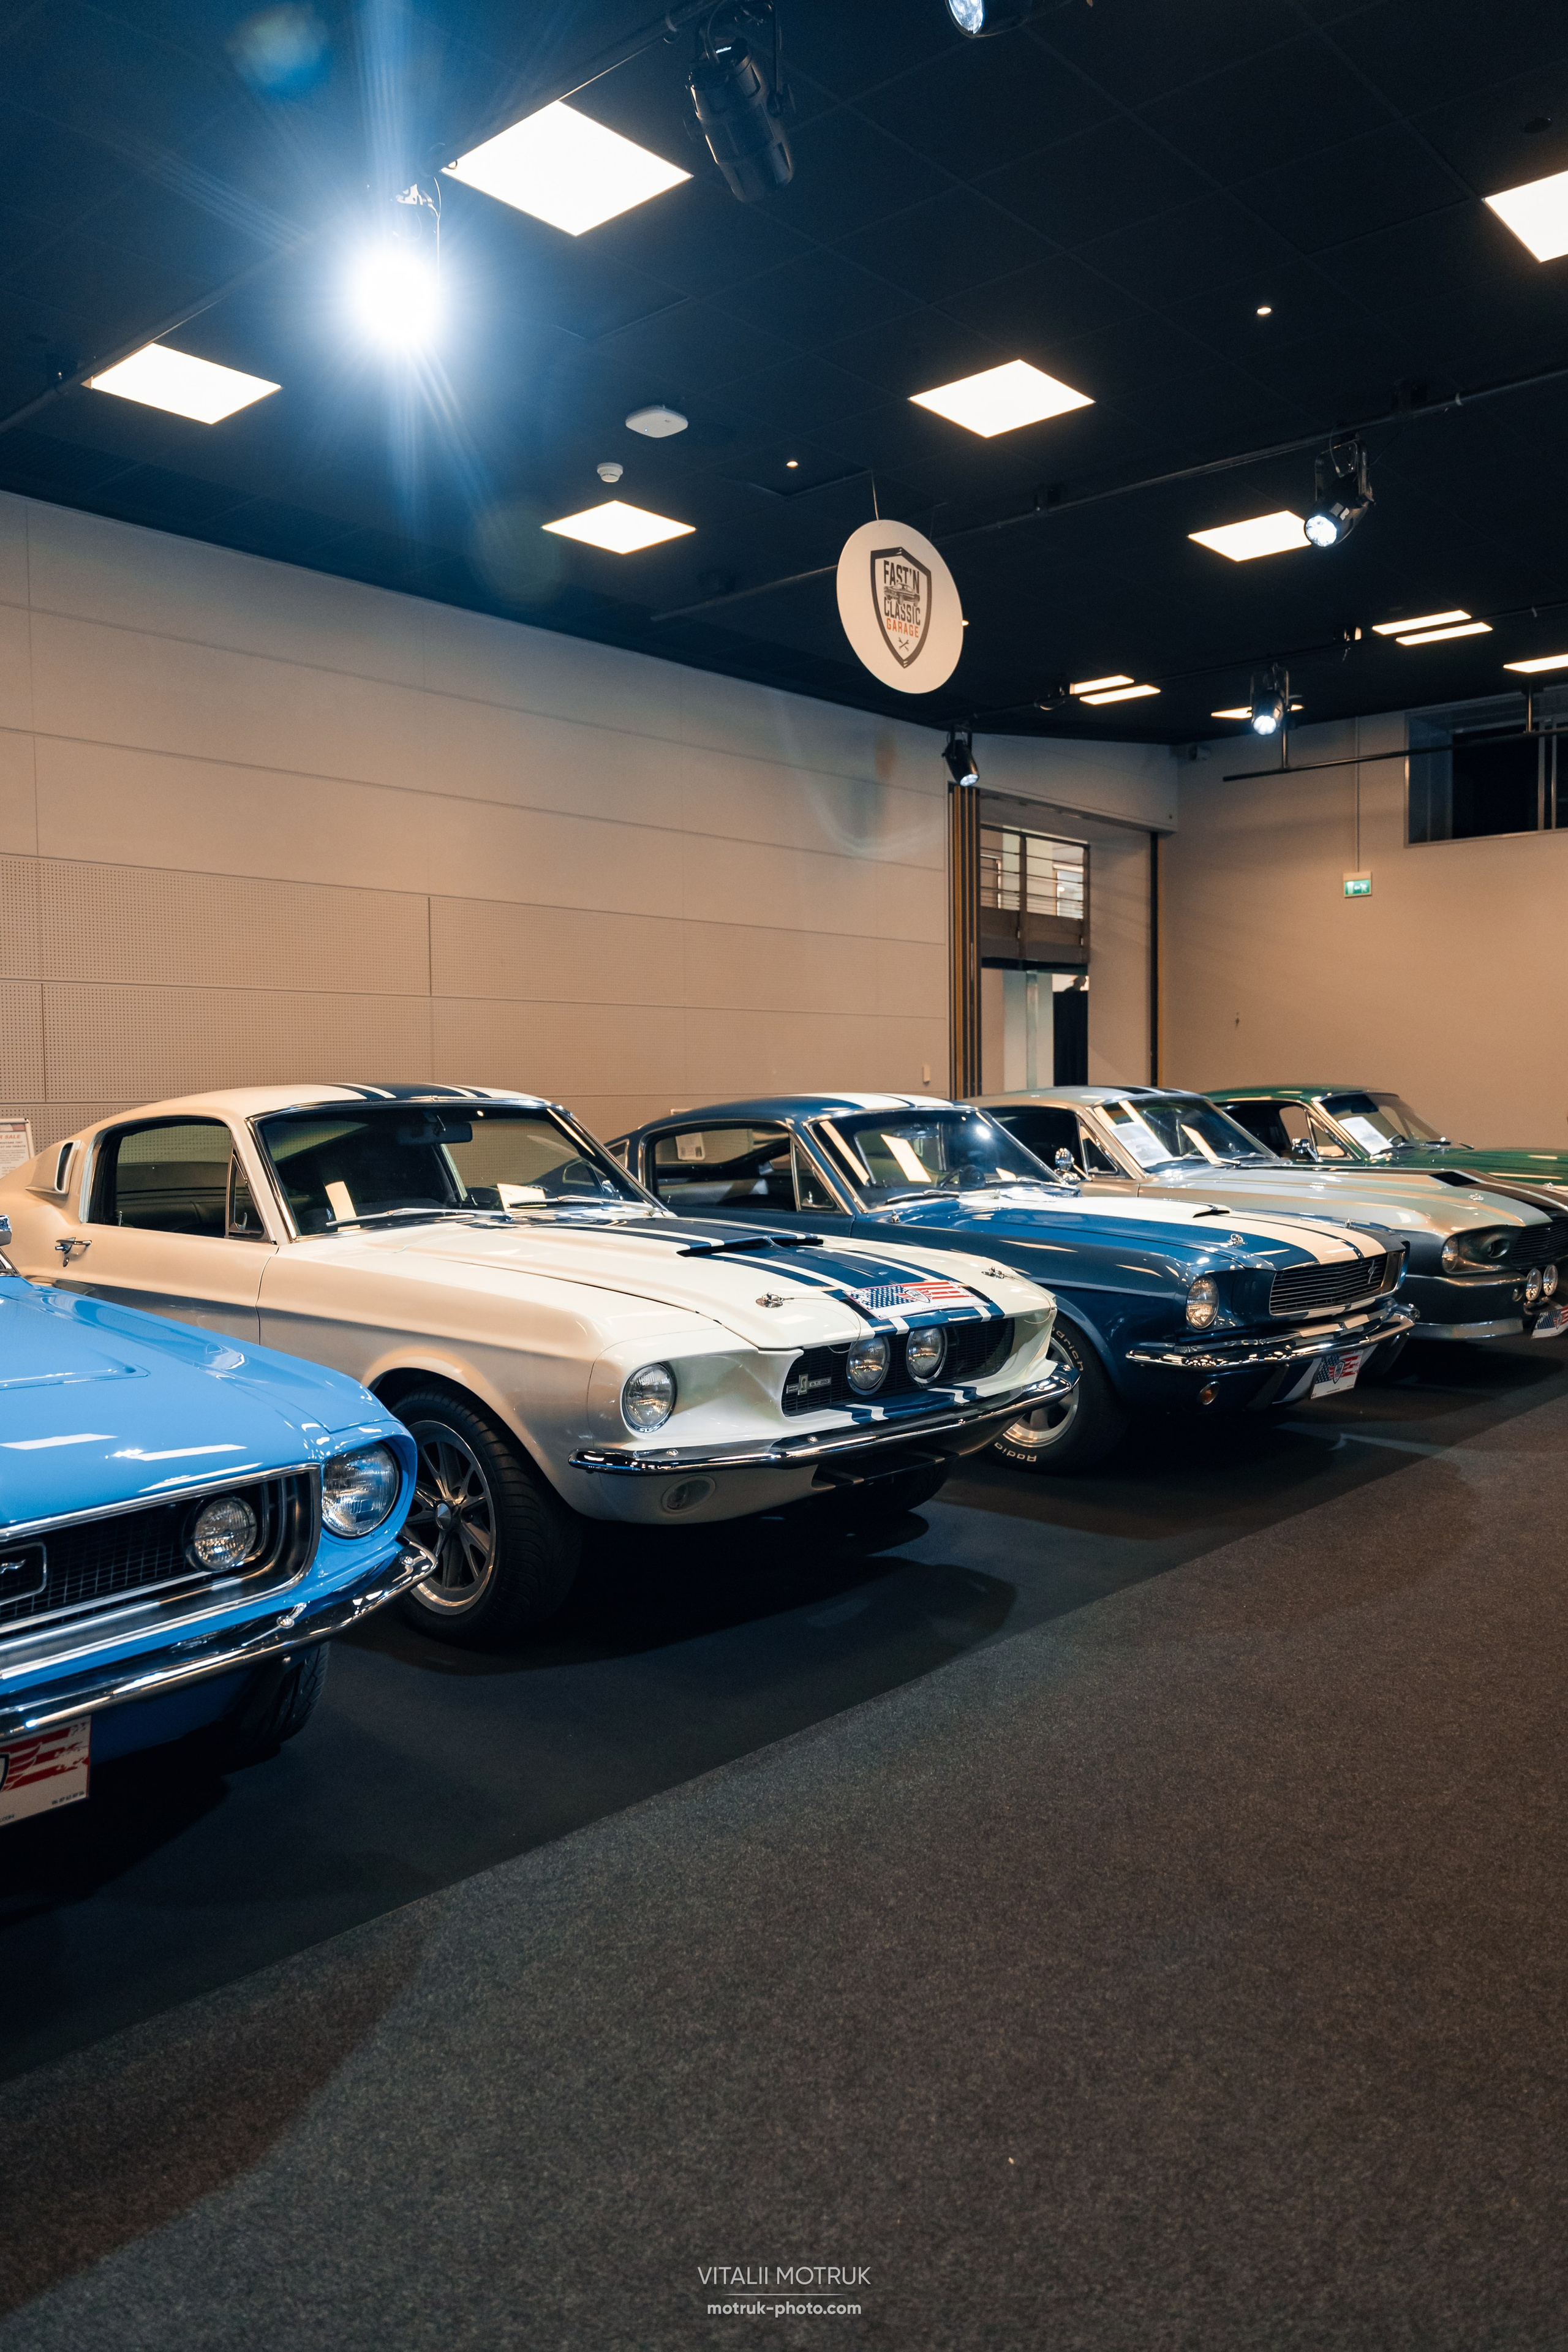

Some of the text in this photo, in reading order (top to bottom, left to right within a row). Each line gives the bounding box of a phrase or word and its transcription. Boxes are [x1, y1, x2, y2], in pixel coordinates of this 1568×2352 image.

[883, 560, 920, 594] FAST'N
[884, 596, 921, 626] CLASSIC
[886, 617, 919, 638] GARAGE
